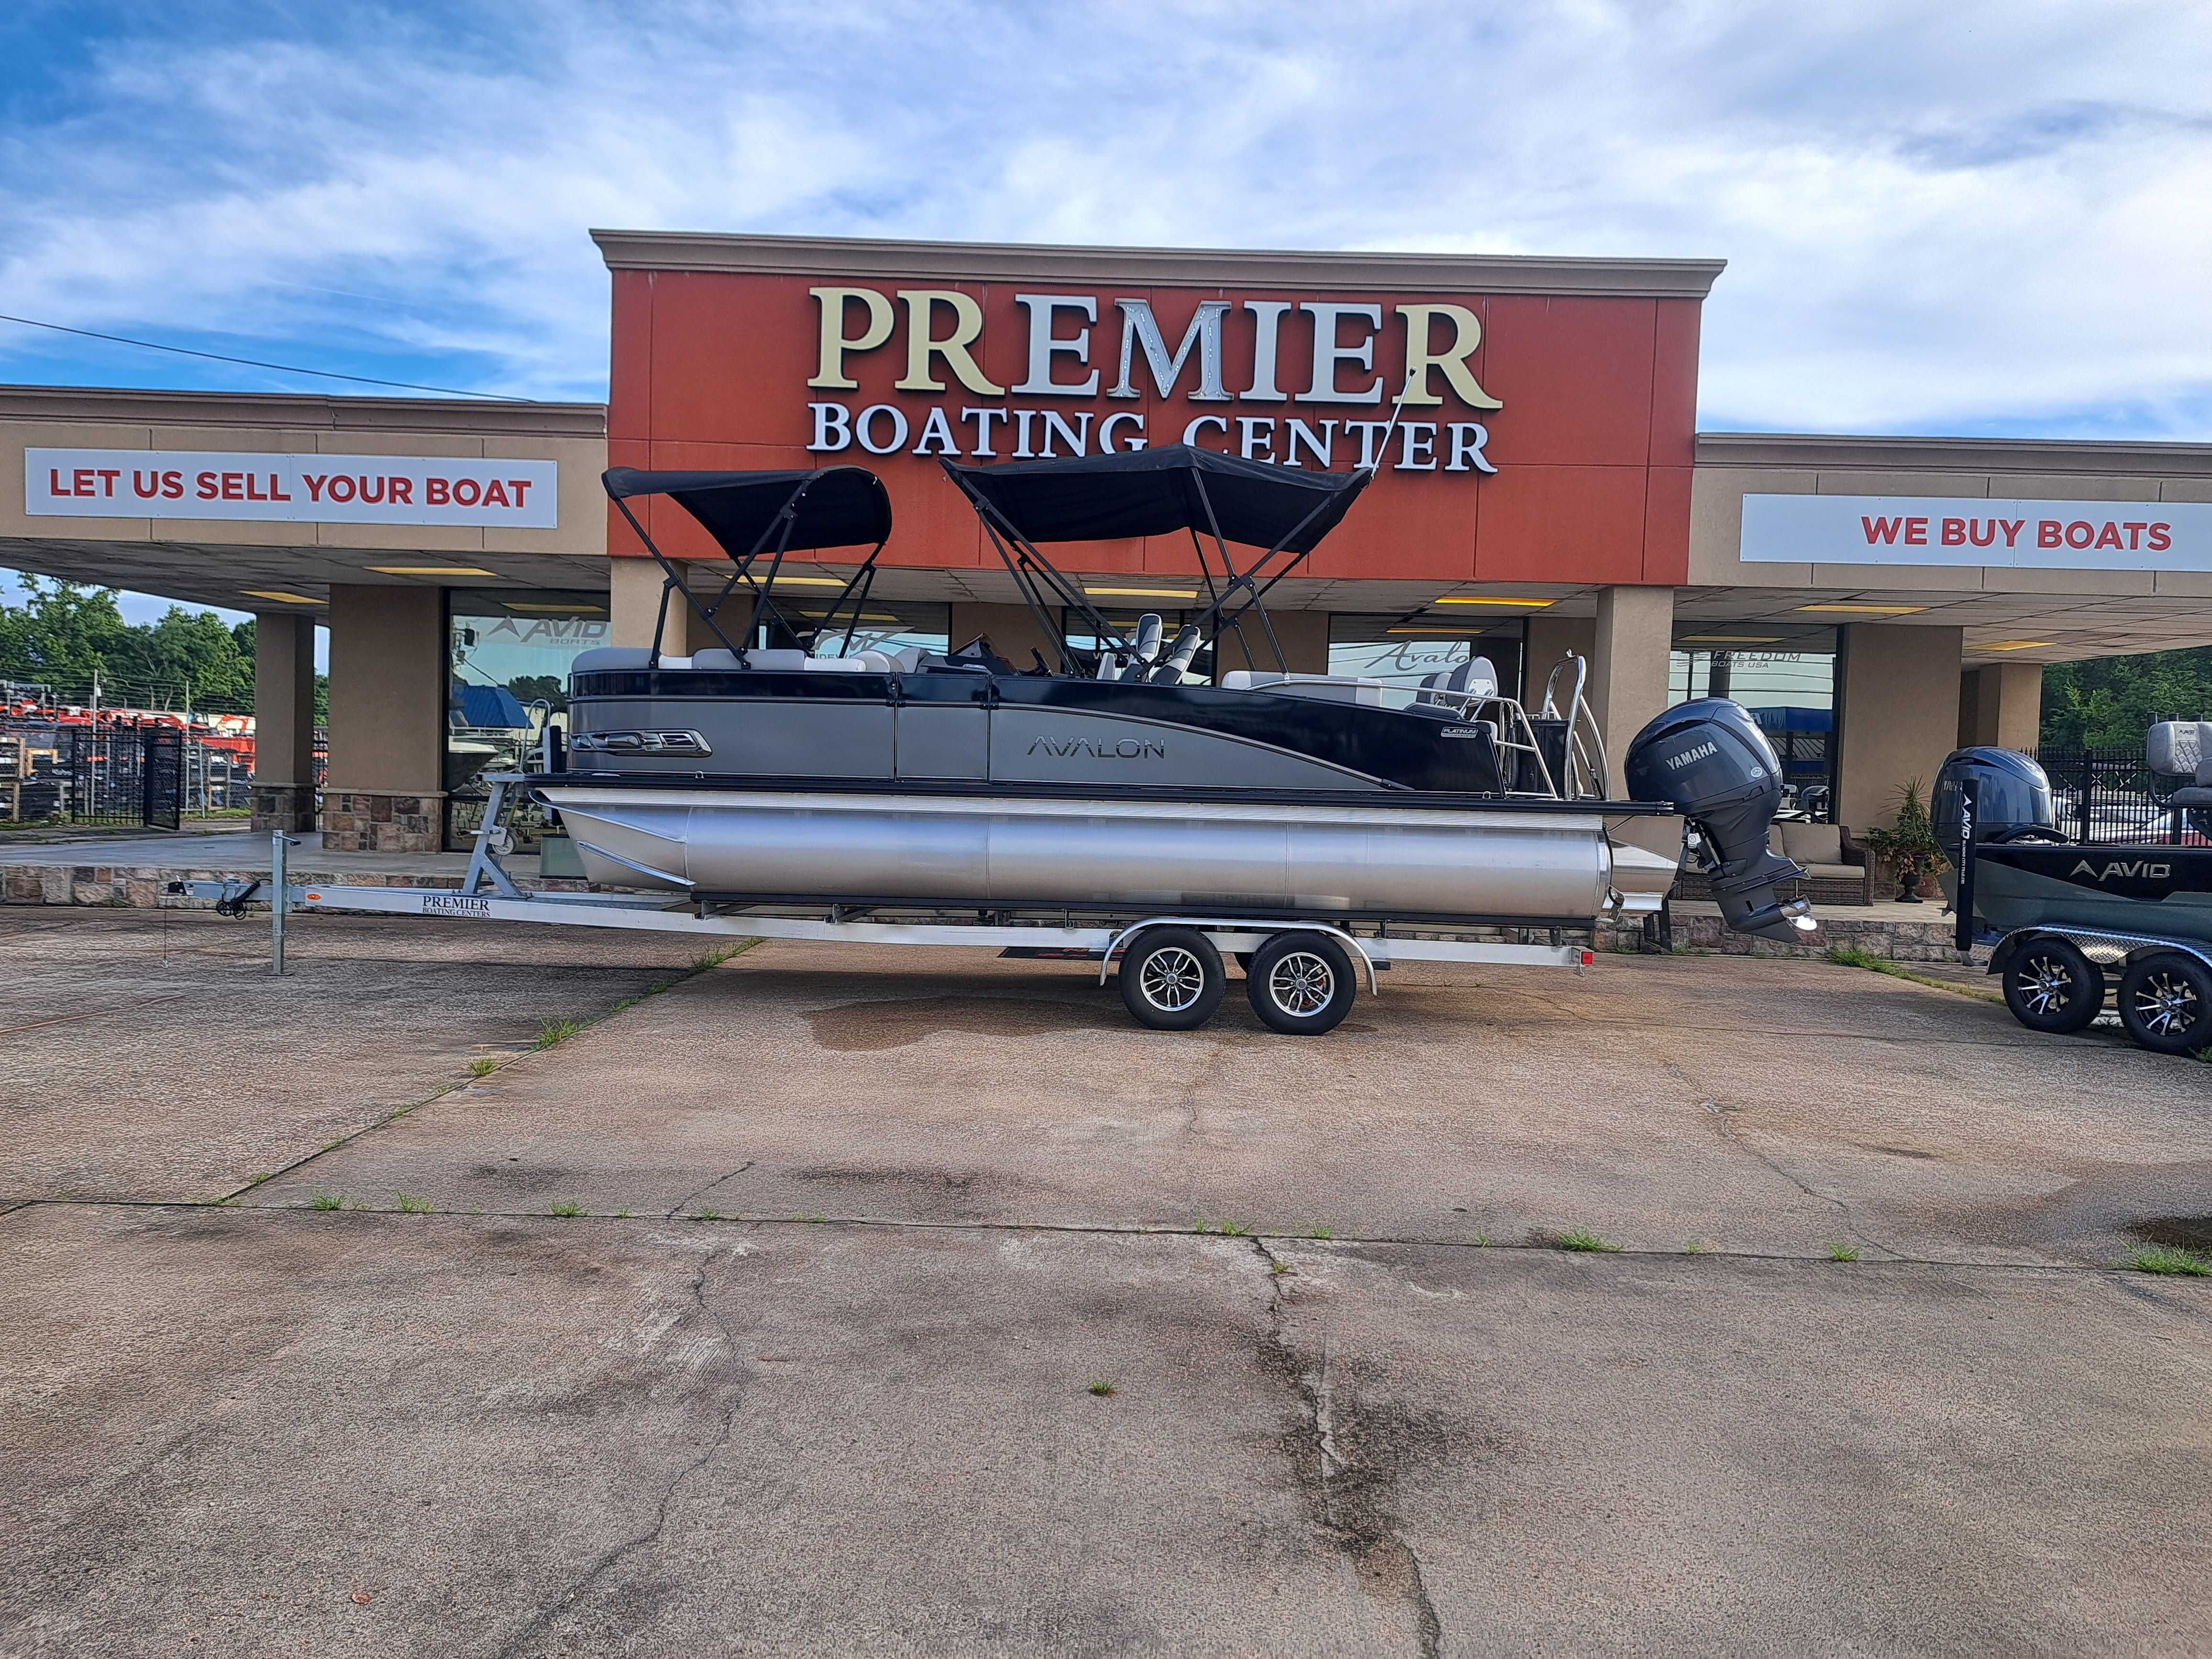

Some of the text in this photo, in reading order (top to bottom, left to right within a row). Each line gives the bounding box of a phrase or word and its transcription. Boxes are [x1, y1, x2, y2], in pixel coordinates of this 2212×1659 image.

[807, 287, 1504, 409] PREMIER
[806, 402, 1499, 473] BOATING CENTER
[51, 469, 532, 508] LET US SELL YOUR BOAT
[1862, 517, 2172, 551] WE BUY BOATS
[520, 616, 608, 643] AVID
[1363, 640, 1477, 671] Avalo
[1714, 650, 1802, 662] FREEDOM
[1027, 735, 1165, 759] AVALON
[1665, 741, 1718, 770] YAMAHA
[1962, 806, 1972, 839] AVID
[2098, 860, 2176, 882] AVID
[422, 896, 490, 911] PREMIER
[422, 907, 490, 917] BOATING CENTERS
